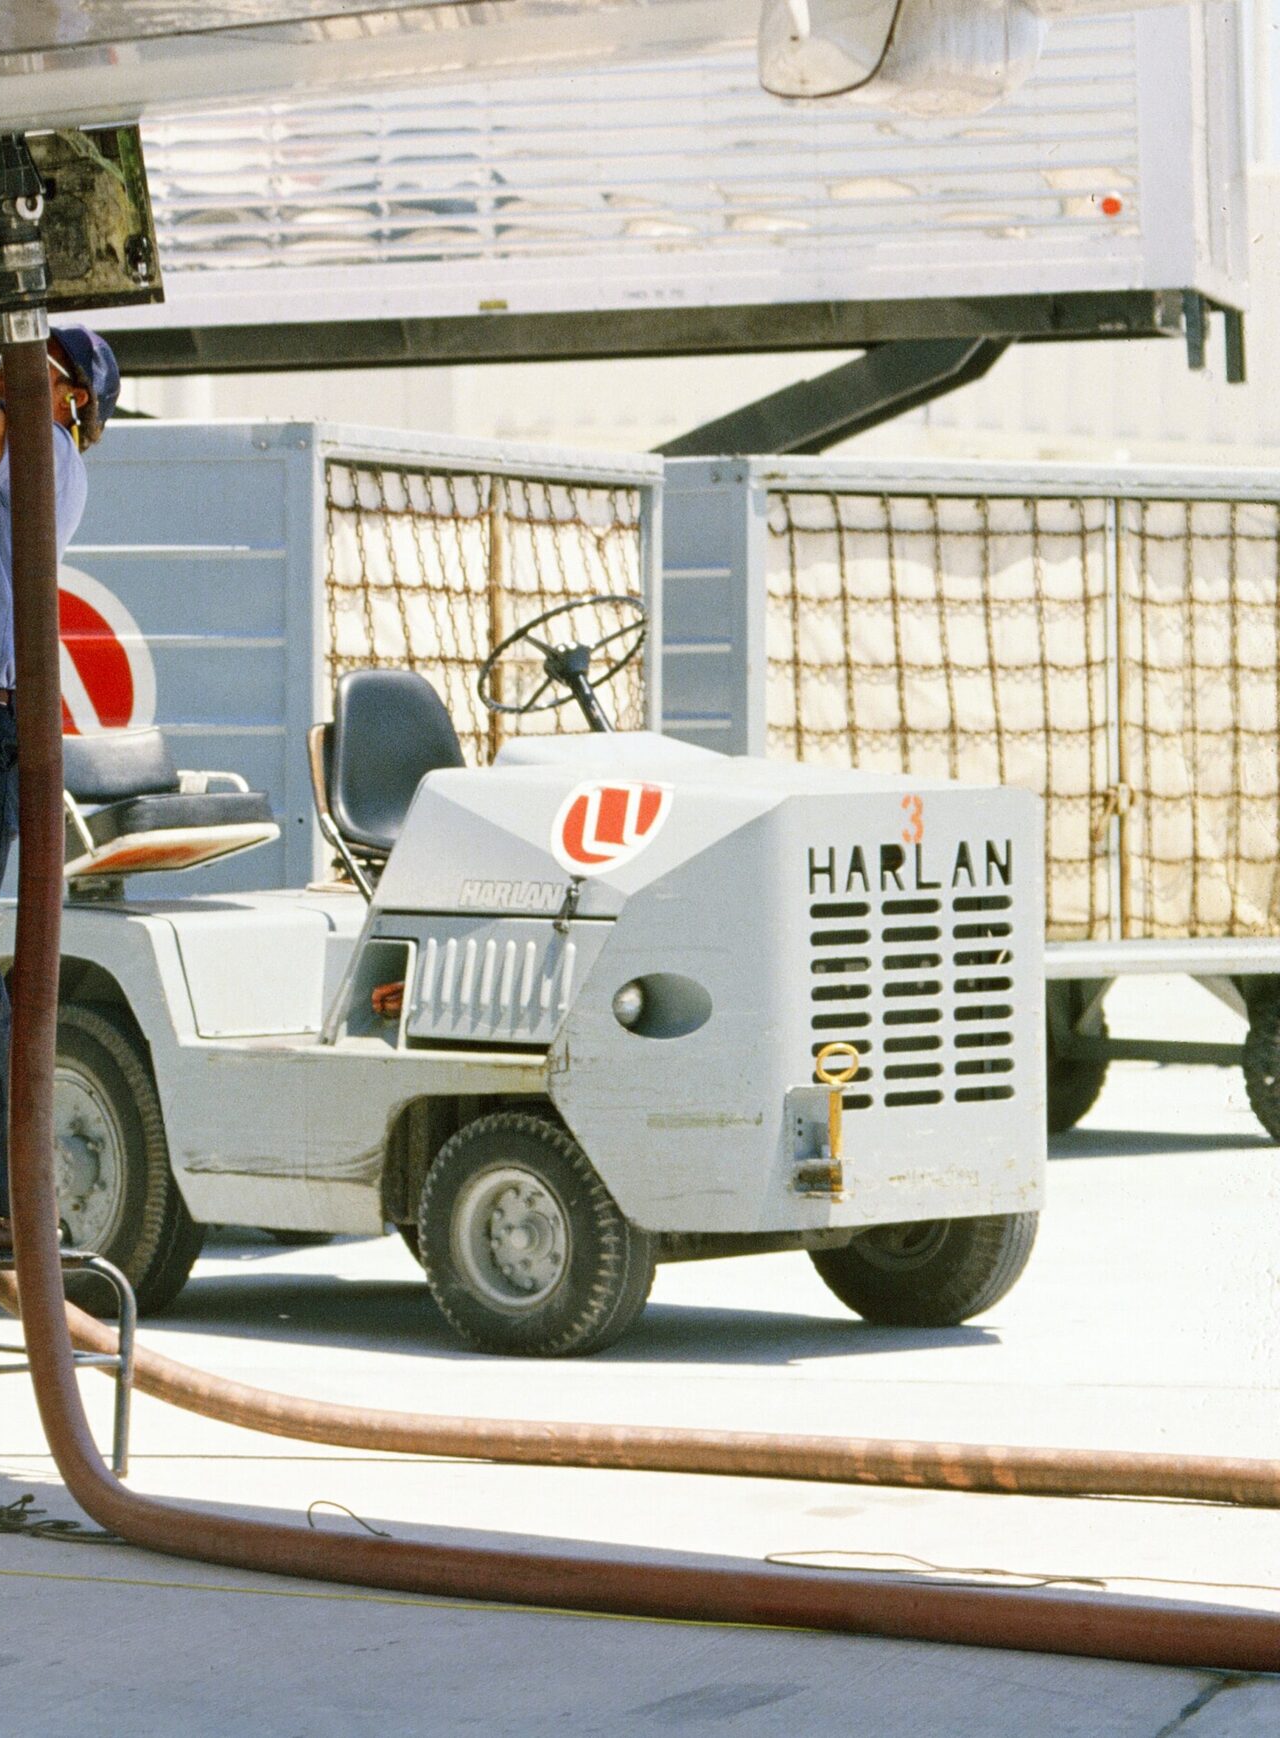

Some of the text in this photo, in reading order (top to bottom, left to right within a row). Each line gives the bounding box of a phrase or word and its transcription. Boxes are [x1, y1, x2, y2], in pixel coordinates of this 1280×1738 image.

[901, 793, 924, 843] 3
[808, 839, 1012, 894] HARLAN
[459, 879, 564, 911] HARLAN
